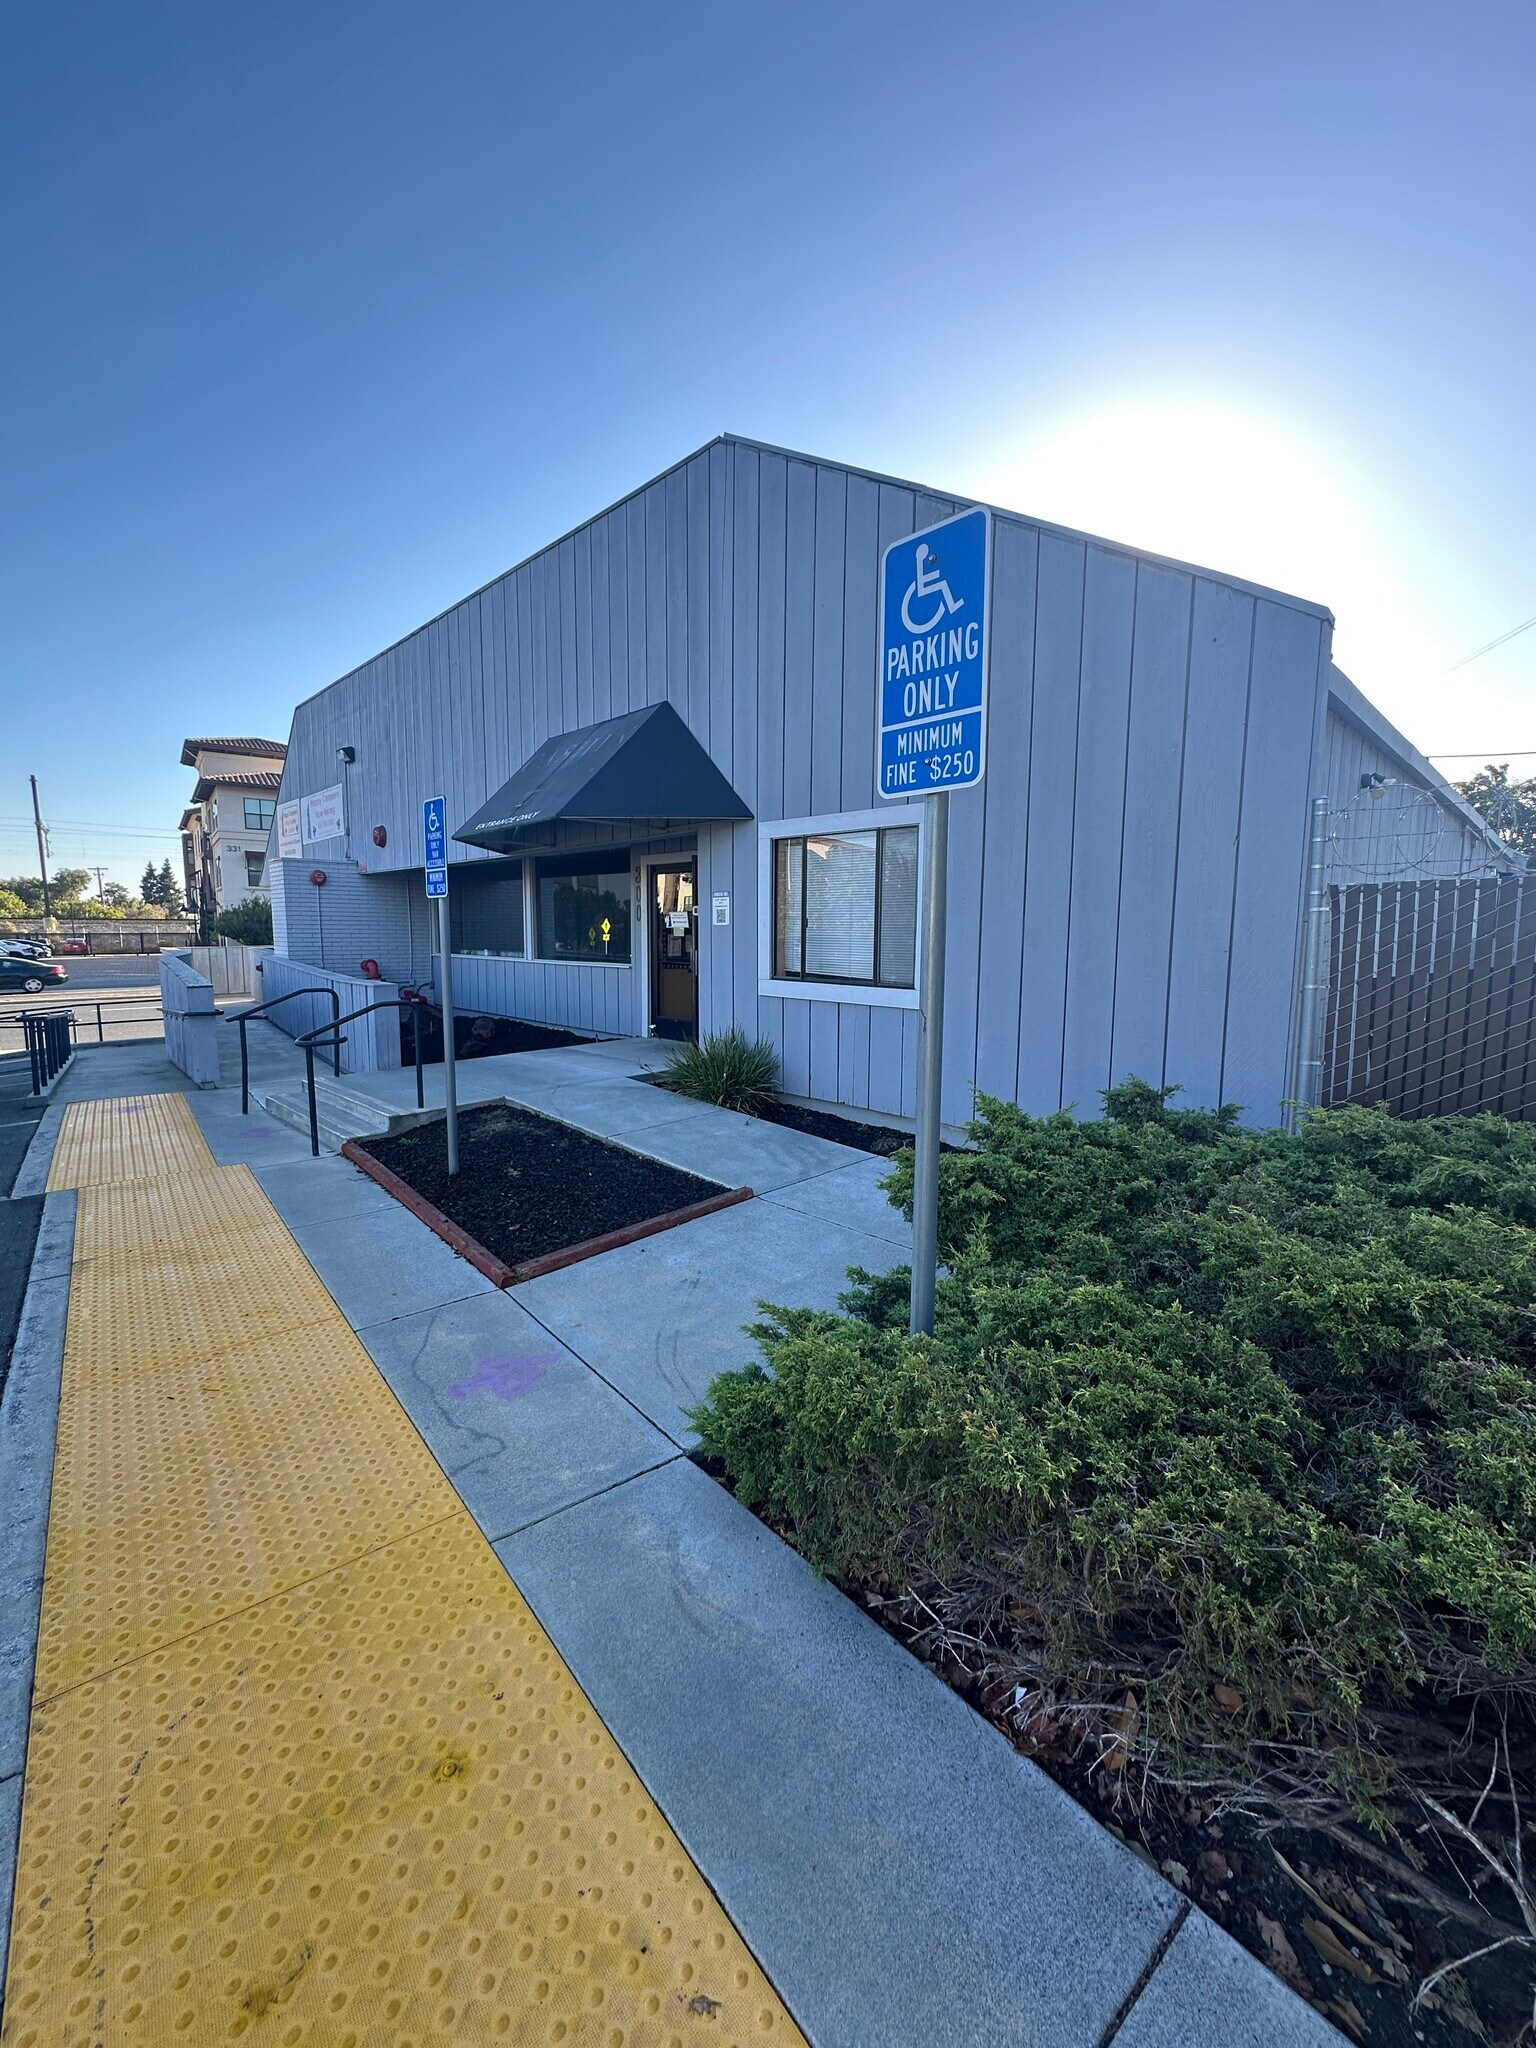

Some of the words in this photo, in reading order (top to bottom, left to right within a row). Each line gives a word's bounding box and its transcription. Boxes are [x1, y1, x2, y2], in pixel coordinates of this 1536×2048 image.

[887, 622, 979, 682] PARKING
[903, 671, 960, 718] ONLY
[897, 721, 963, 757] MINIMUM
[886, 760, 917, 787] FINE
[929, 750, 974, 782] $250
[475, 815, 518, 830] ENTRANCE
[516, 810, 540, 822] ONLY
